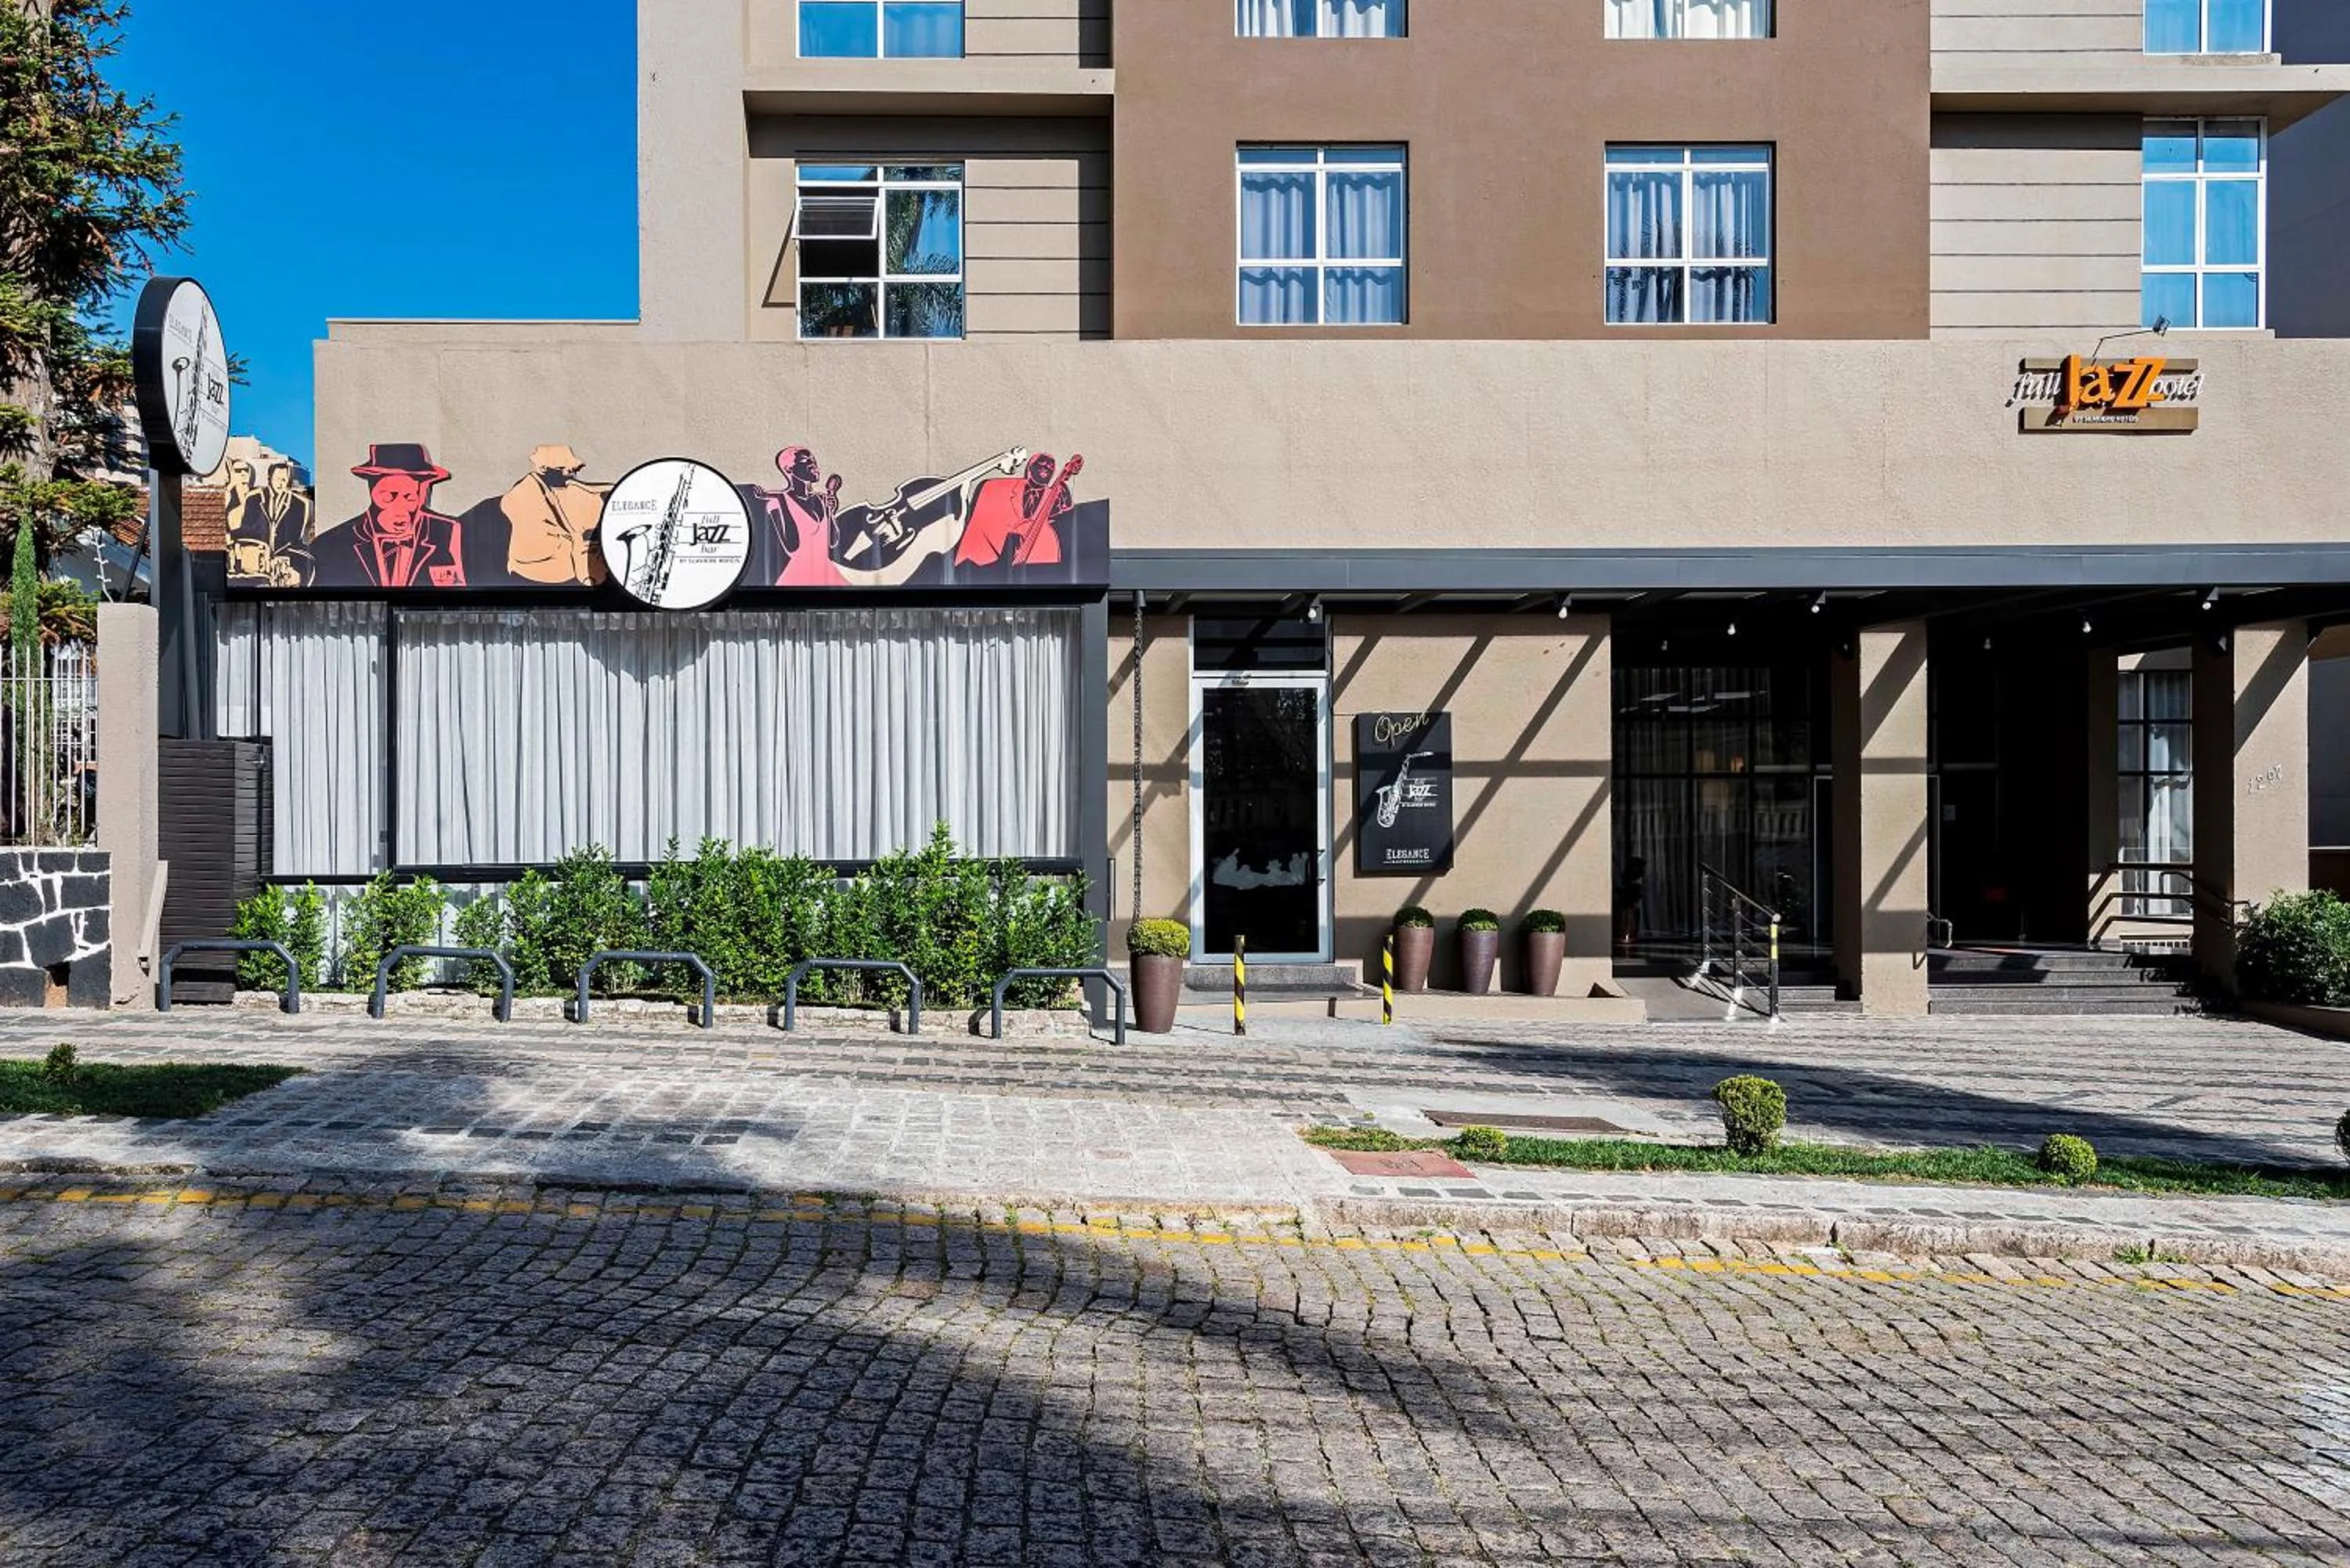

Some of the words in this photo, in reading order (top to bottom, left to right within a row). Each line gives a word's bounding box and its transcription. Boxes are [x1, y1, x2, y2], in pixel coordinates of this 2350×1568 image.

[2011, 372, 2062, 401] full
[612, 500, 657, 511] ELEGANCE
[689, 522, 730, 546] Jazz
[1375, 714, 1429, 747] Open
[1386, 848, 1430, 859] ELEGANCE
